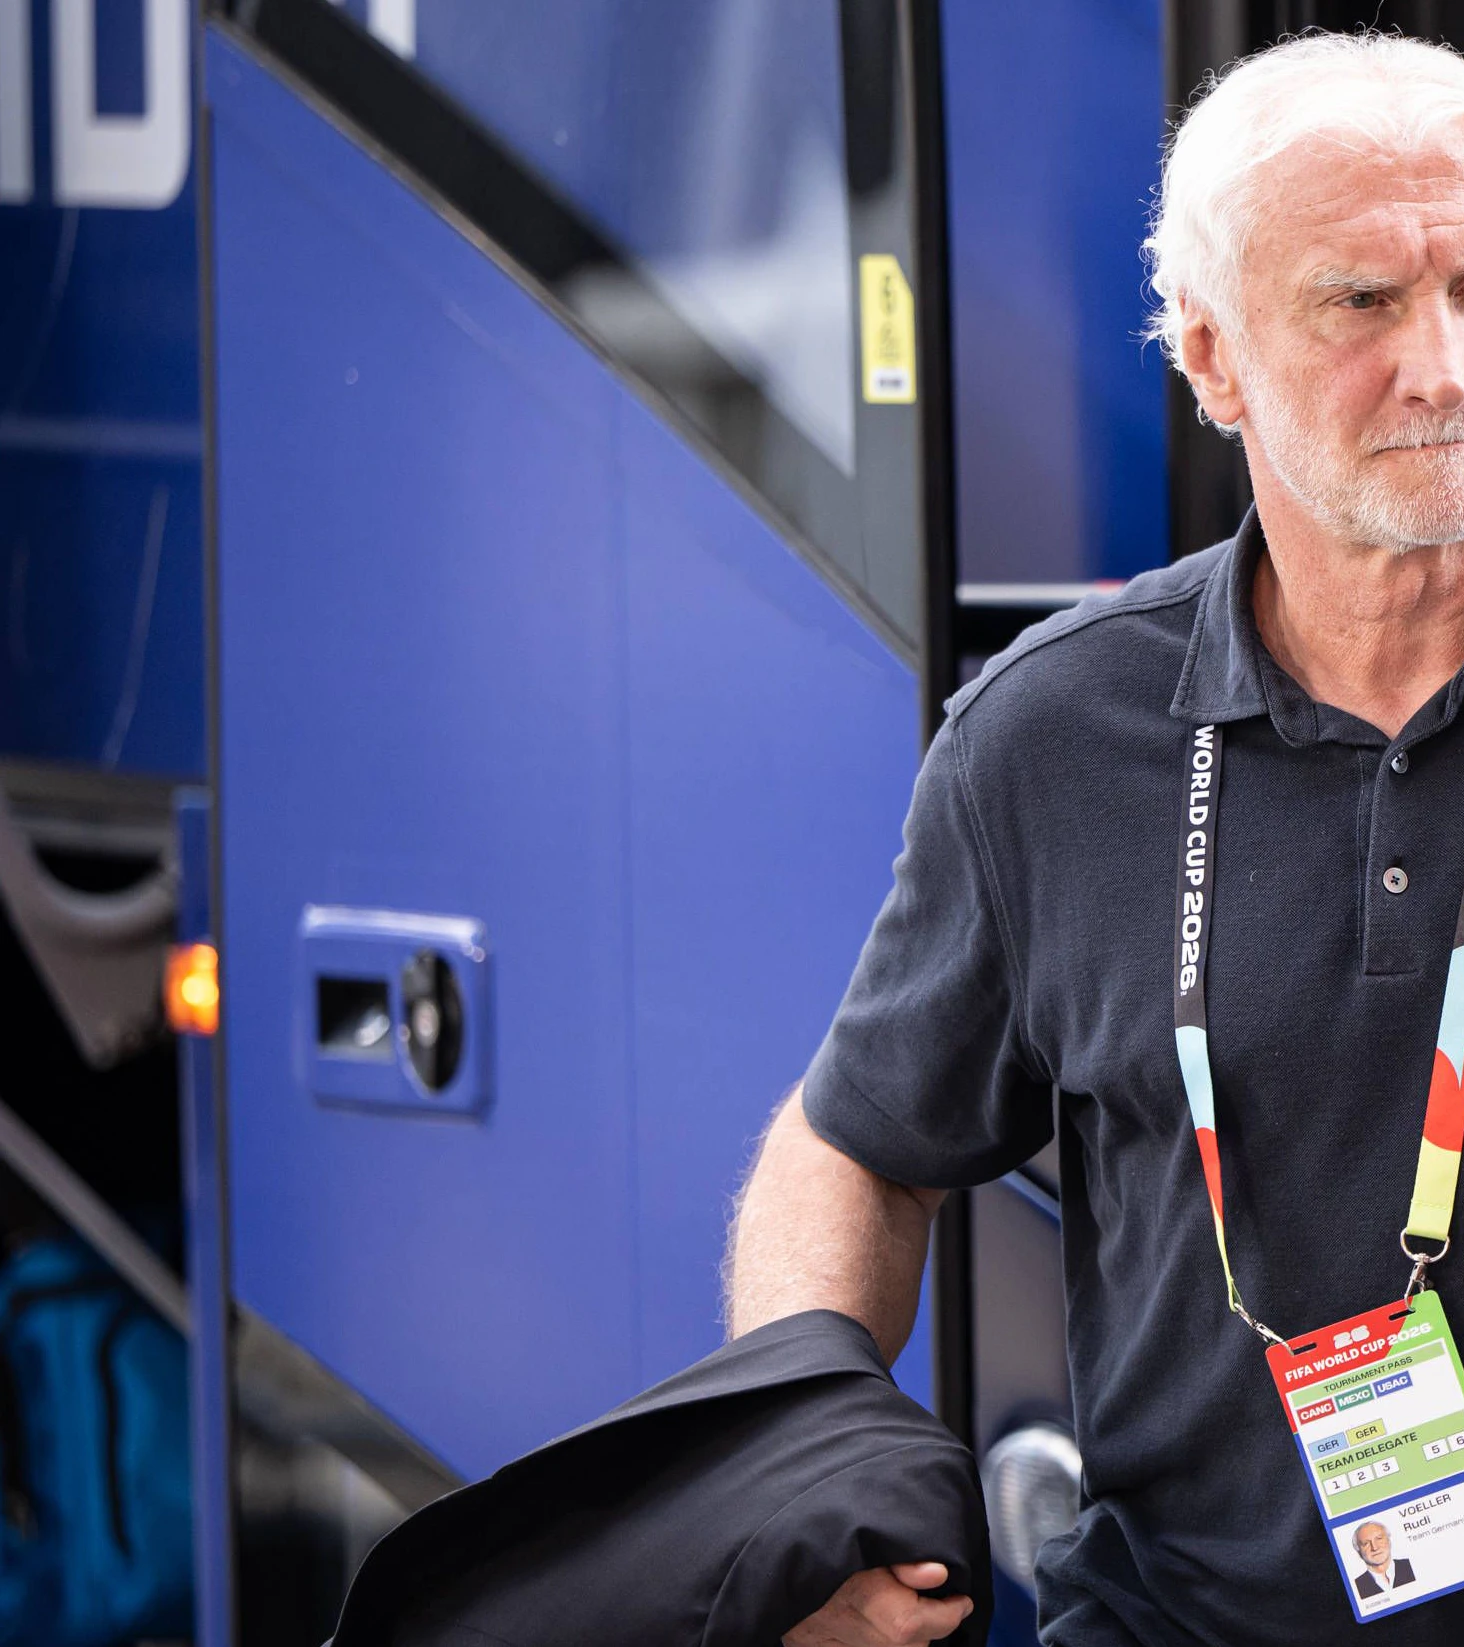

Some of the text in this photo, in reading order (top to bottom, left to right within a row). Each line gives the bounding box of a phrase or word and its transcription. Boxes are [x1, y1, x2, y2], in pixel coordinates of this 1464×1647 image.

[1188, 724, 1214, 826] WORLD
[1184, 831, 1207, 887] CUP
[1285, 1323, 1432, 1382] FIFA WORLD CUP 2026
[1324, 1356, 1413, 1392] TOURNAMENT PASS
[1300, 1376, 1408, 1421] CANC MEXC USAC
[1318, 1425, 1378, 1453] GER GER
[1319, 1432, 1418, 1474] TEAM DELEGATE
[1332, 1480, 1341, 1490] 1
[1357, 1471, 1367, 1482] 2
[1382, 1462, 1392, 1473] 3
[1431, 1444, 1441, 1455] 5
[1398, 1494, 1452, 1519] VOELLER
[1403, 1516, 1431, 1533] Rudi
[1407, 1531, 1433, 1544] Team
